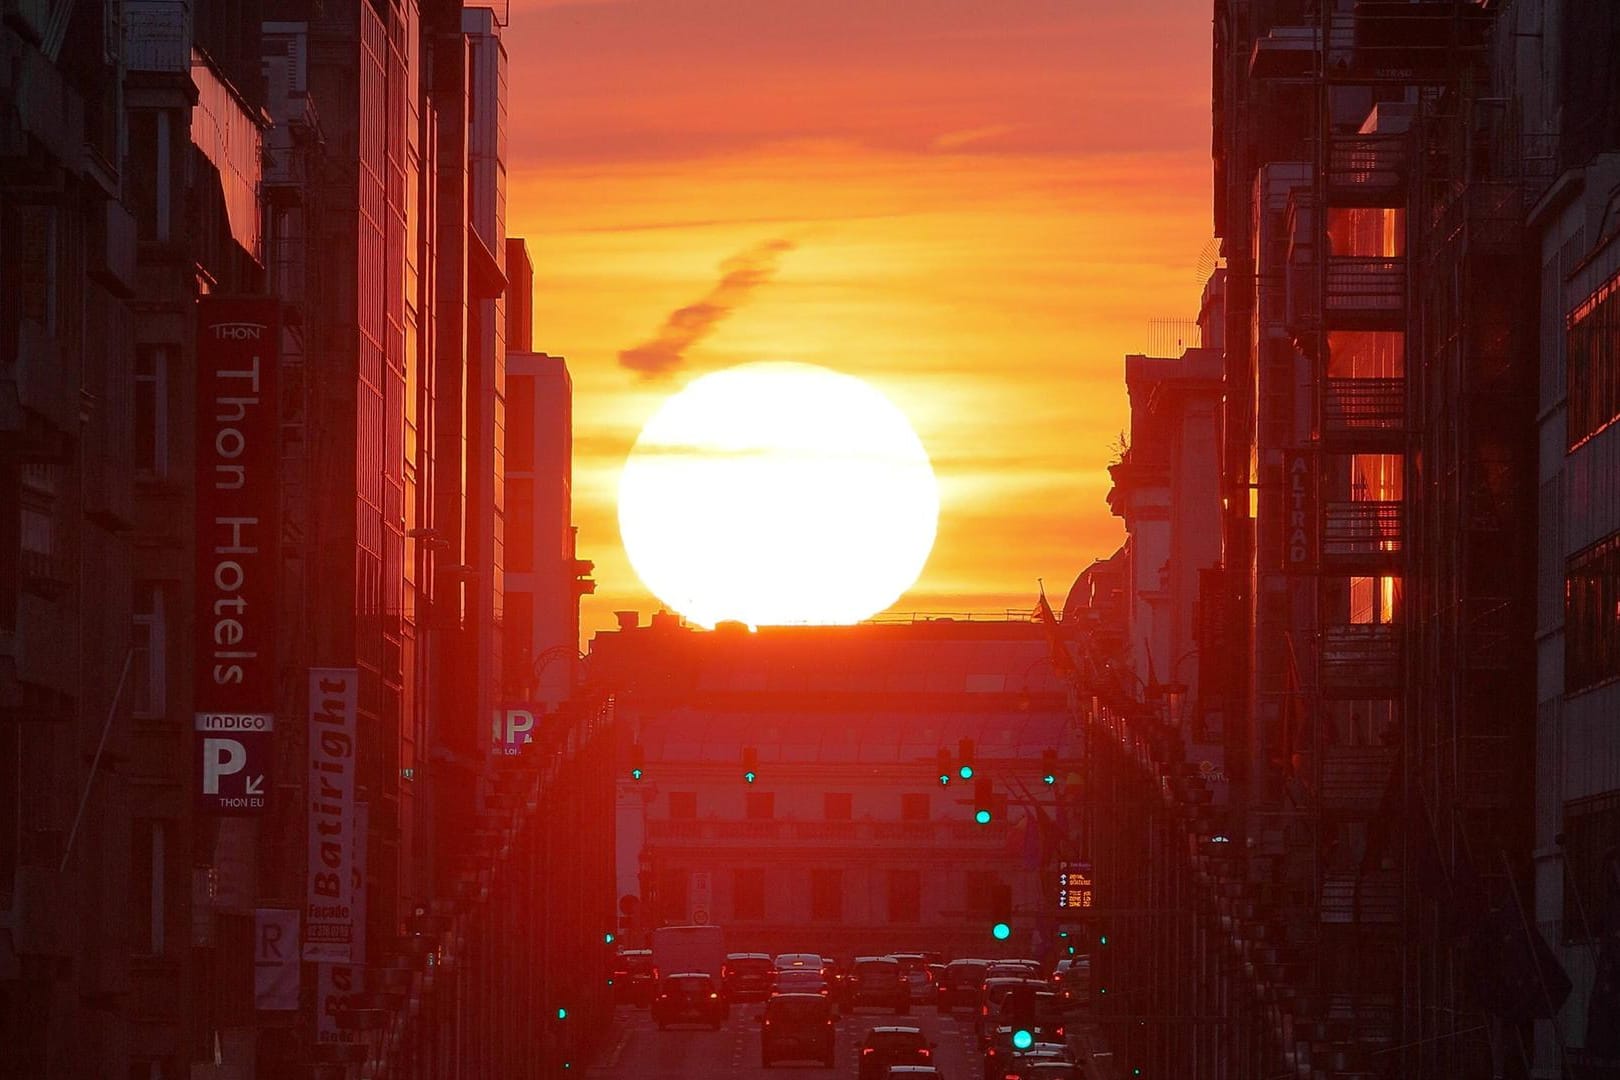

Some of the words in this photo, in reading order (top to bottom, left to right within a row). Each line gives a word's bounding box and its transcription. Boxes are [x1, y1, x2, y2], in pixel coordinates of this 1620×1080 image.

[211, 322, 263, 340] THON
[215, 356, 260, 489] Thon
[214, 517, 259, 685] Hotels
[205, 715, 265, 730] INDIGO
[506, 709, 534, 744] P
[202, 737, 248, 795] P
[312, 678, 352, 898] Batiright
[219, 797, 248, 809] THON
[250, 797, 265, 809] EU
